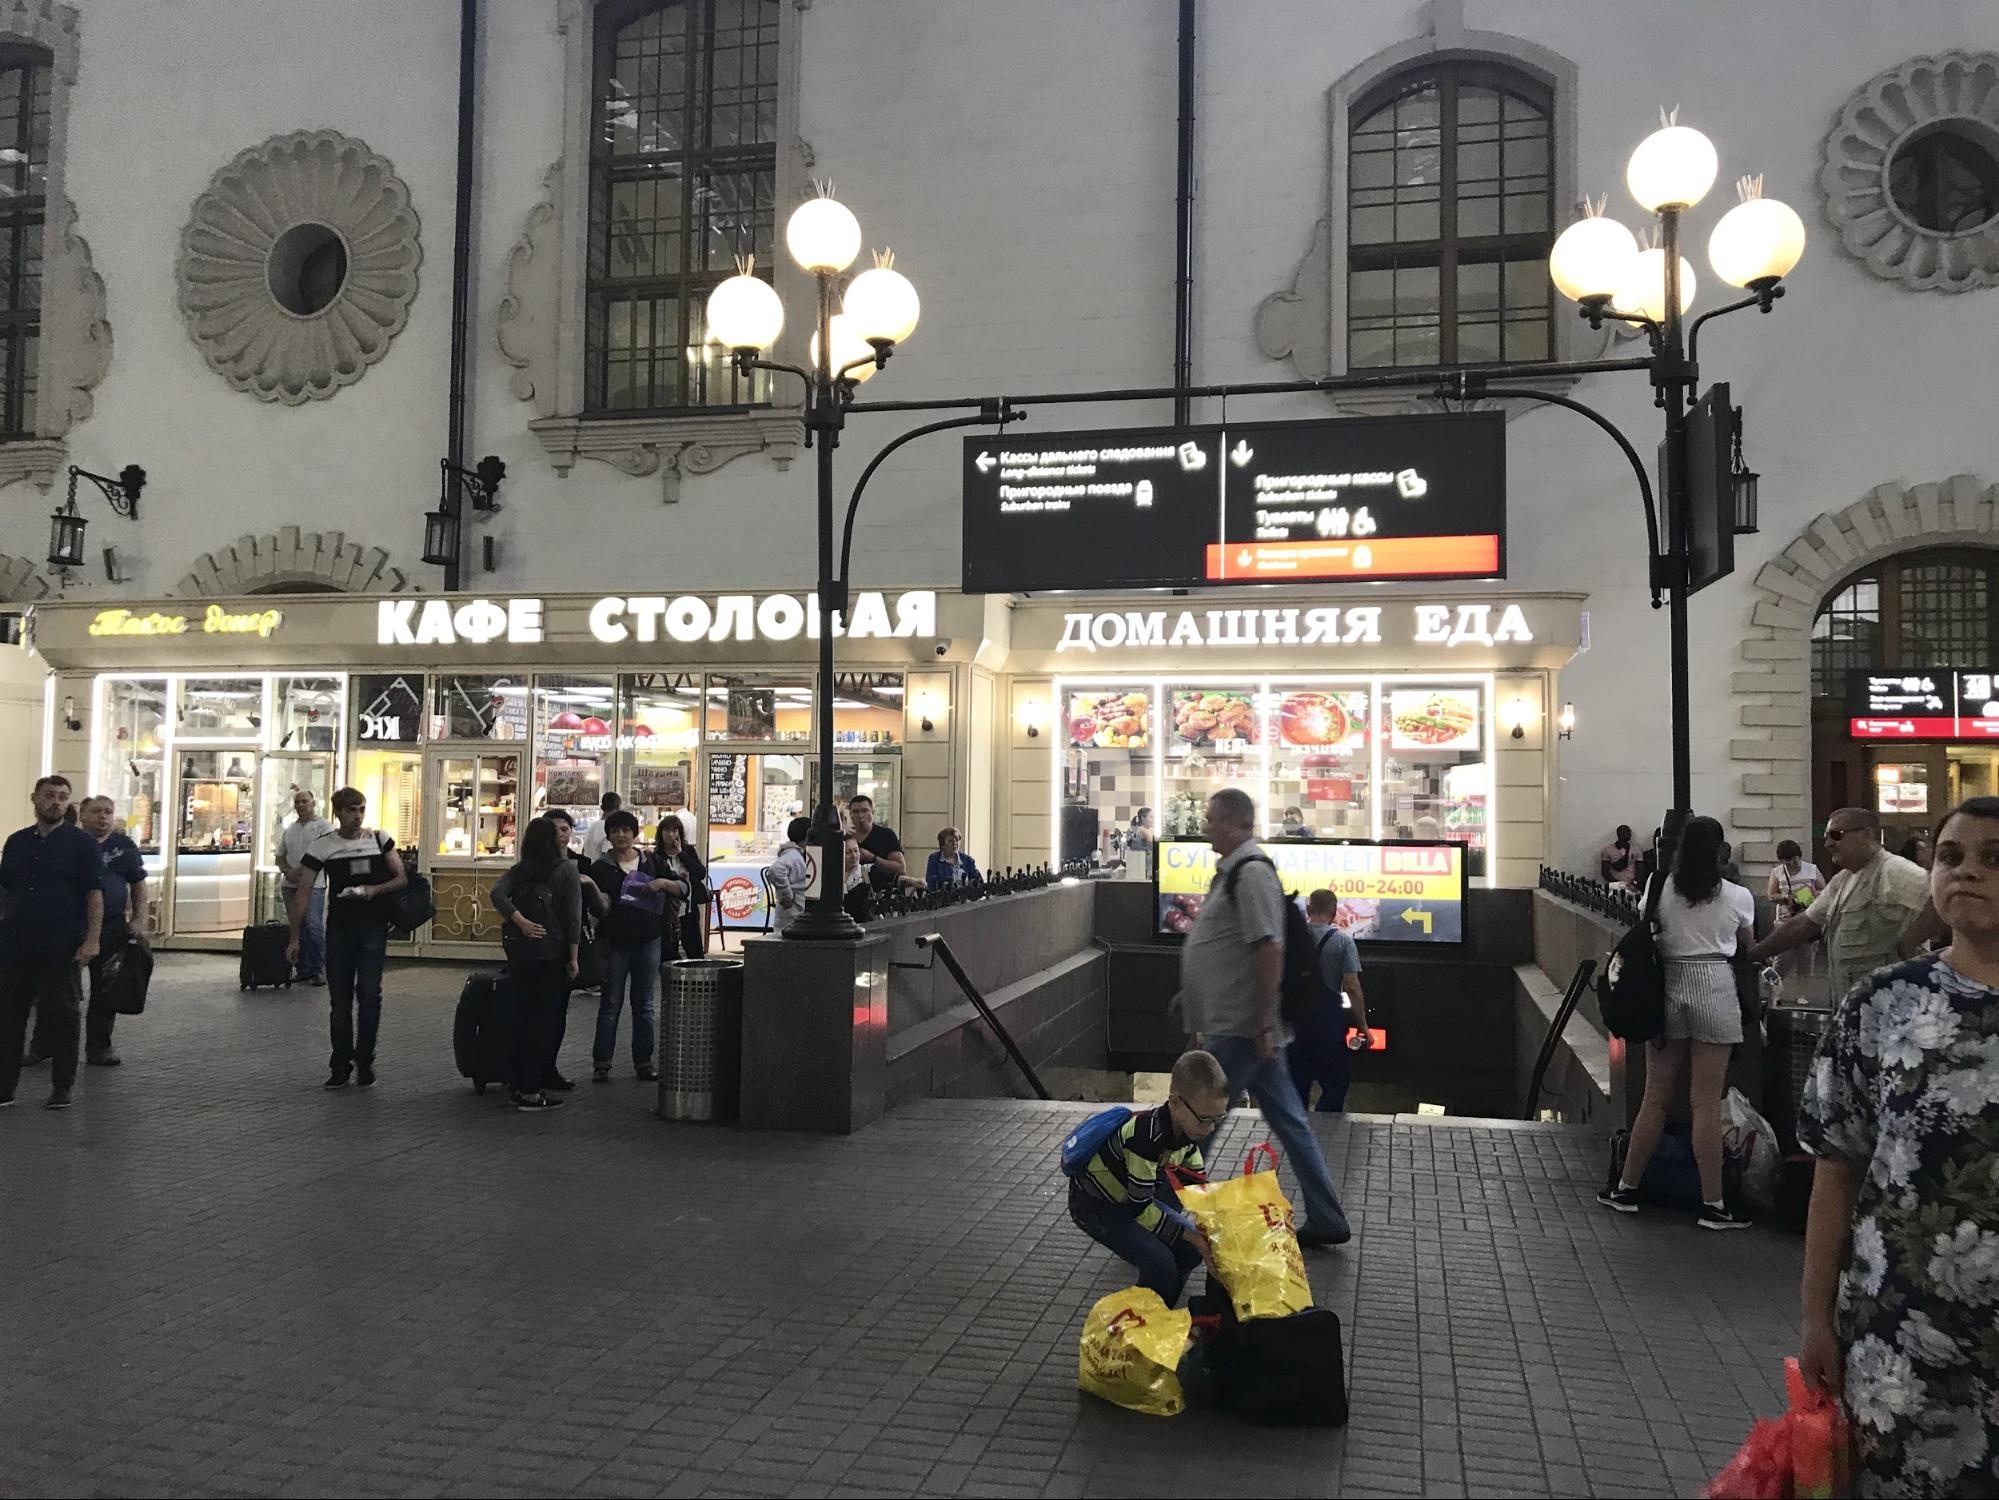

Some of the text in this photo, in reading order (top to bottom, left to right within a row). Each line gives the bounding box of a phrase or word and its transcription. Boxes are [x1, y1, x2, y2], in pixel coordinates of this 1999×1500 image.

[1001, 446, 1175, 464] Кассы дальнего следования
[1001, 465, 1096, 479] Long-distance tickets
[1001, 482, 1132, 500] Пригородные поезда
[1001, 500, 1070, 511] Suburban trains
[378, 599, 544, 644] КАФЕ
[1055, 604, 1534, 652] ДОМАШНЯЯ ЕДА
[1385, 852, 1449, 873] BILLA
